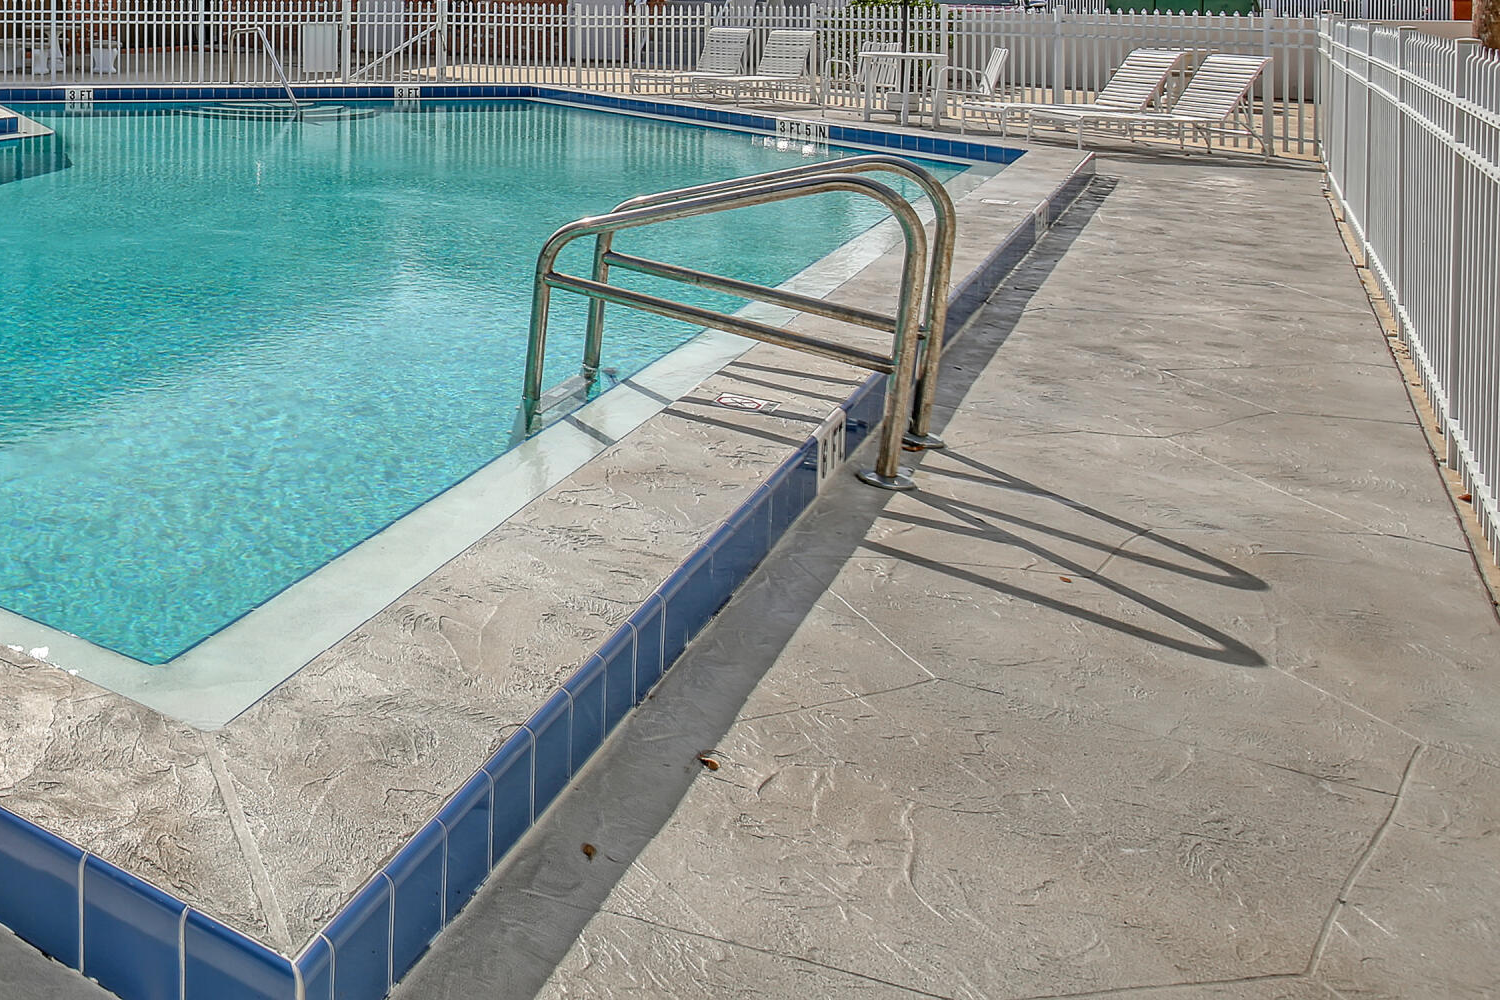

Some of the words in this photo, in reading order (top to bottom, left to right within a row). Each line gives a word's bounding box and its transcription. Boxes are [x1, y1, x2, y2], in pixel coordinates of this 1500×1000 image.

[69, 90, 76, 100] 3
[398, 88, 403, 98] 3
[780, 121, 786, 133] 3
[805, 124, 811, 136] 5
[815, 125, 828, 138] IN.
